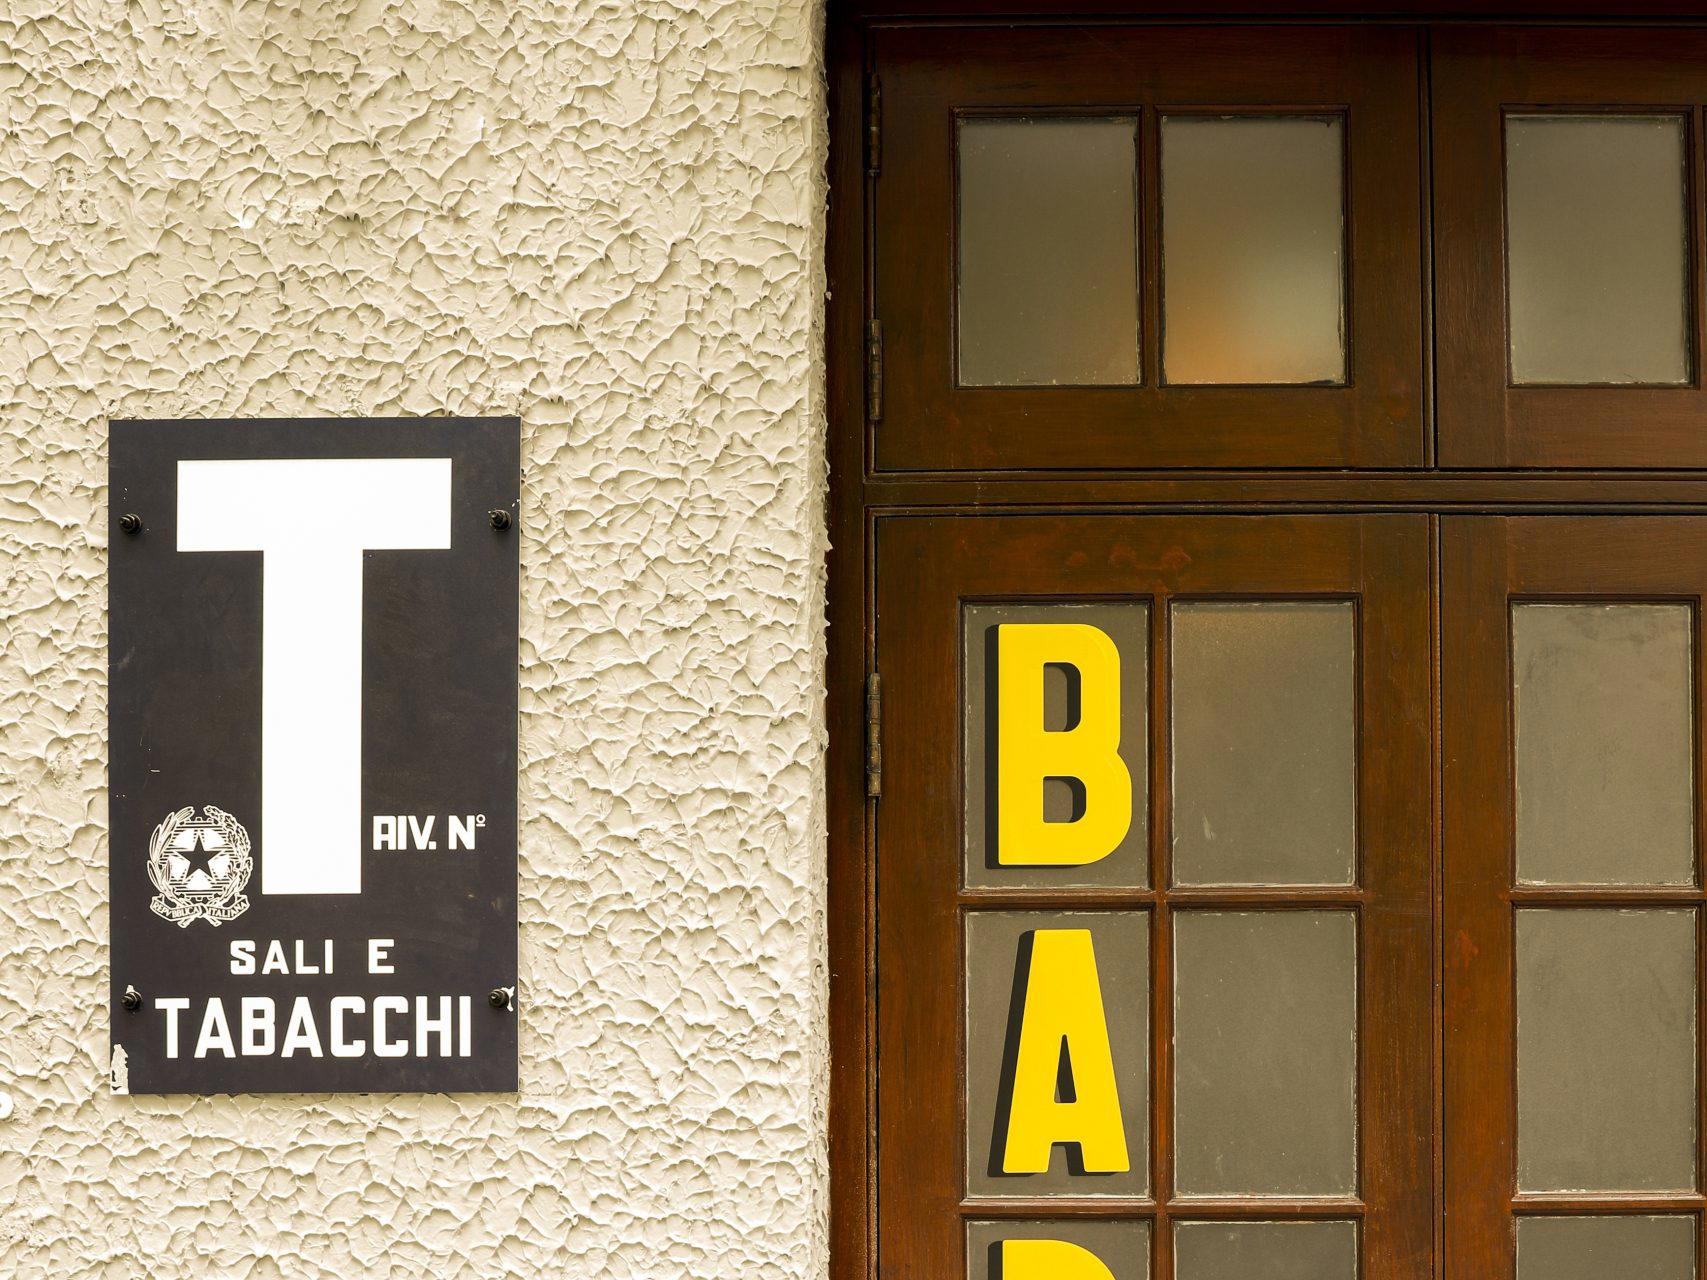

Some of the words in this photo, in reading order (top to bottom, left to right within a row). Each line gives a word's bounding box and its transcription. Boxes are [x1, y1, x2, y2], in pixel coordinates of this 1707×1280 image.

[176, 457, 452, 896] T
[207, 901, 247, 917] ITALIANA
[230, 939, 334, 975] SALI
[368, 938, 395, 974] E
[154, 995, 472, 1059] TABACCHI
